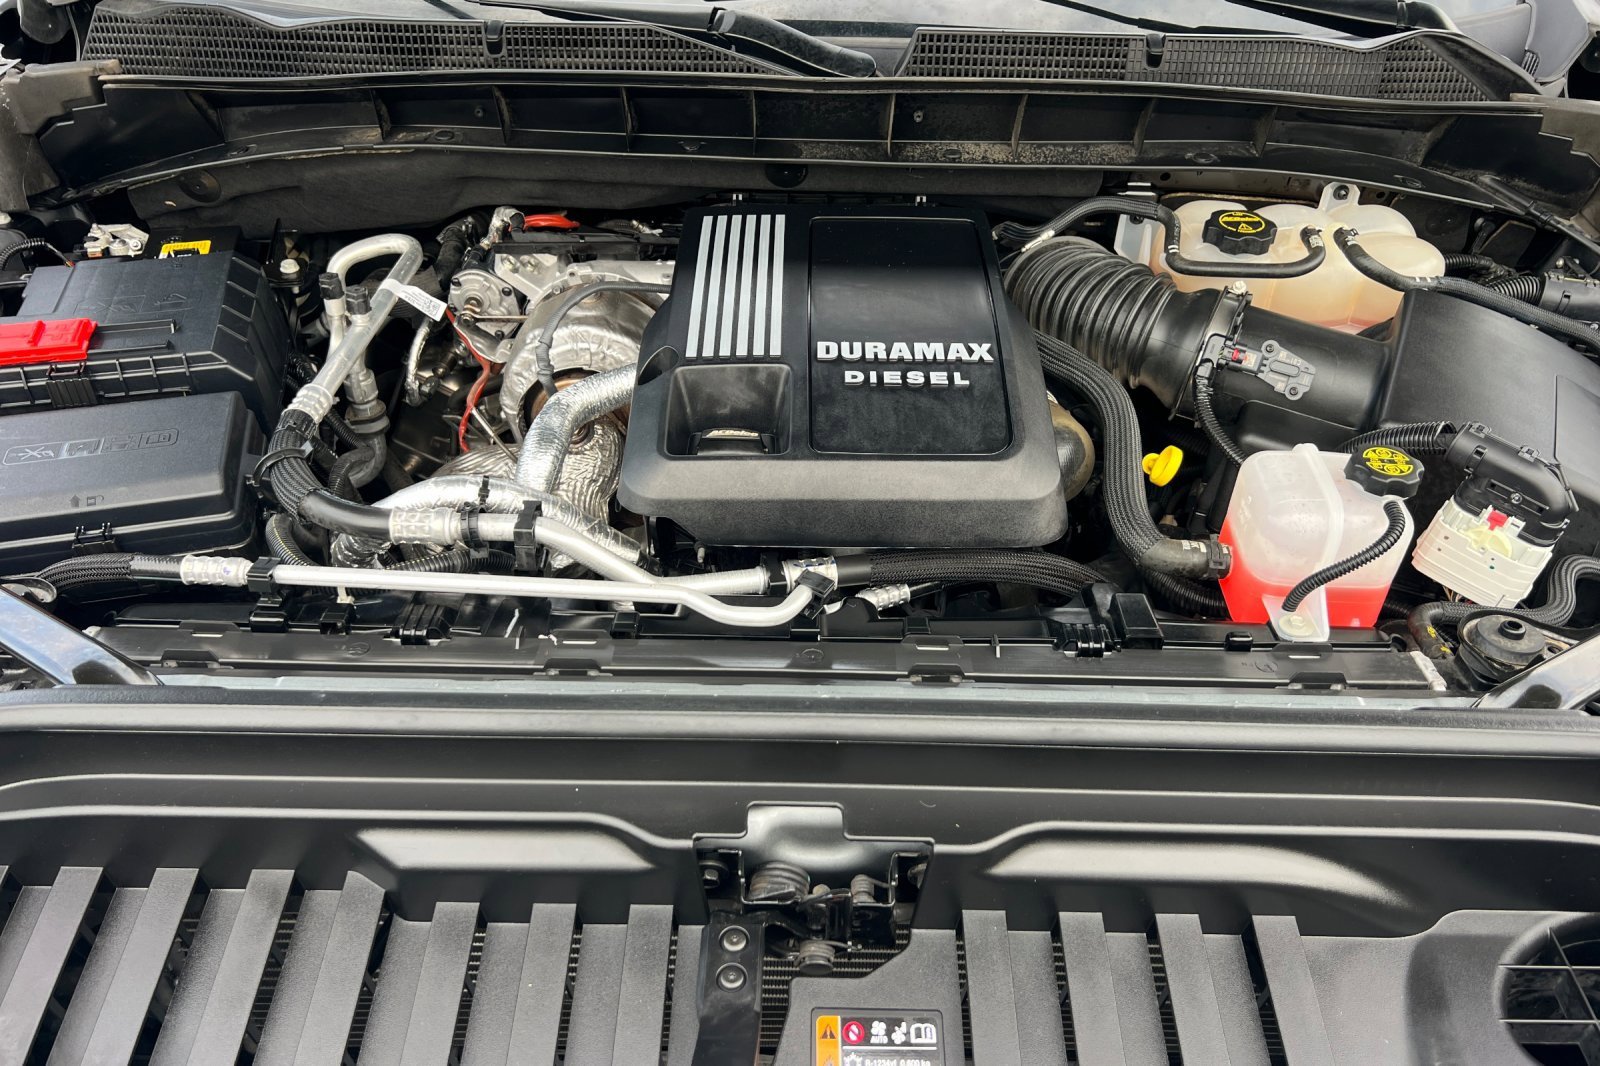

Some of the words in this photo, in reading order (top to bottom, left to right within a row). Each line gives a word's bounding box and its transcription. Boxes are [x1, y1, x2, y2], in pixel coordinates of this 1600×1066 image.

[816, 341, 994, 362] DURAMAX
[844, 370, 970, 387] DIESEL
[870, 1035, 888, 1044] AUTO
